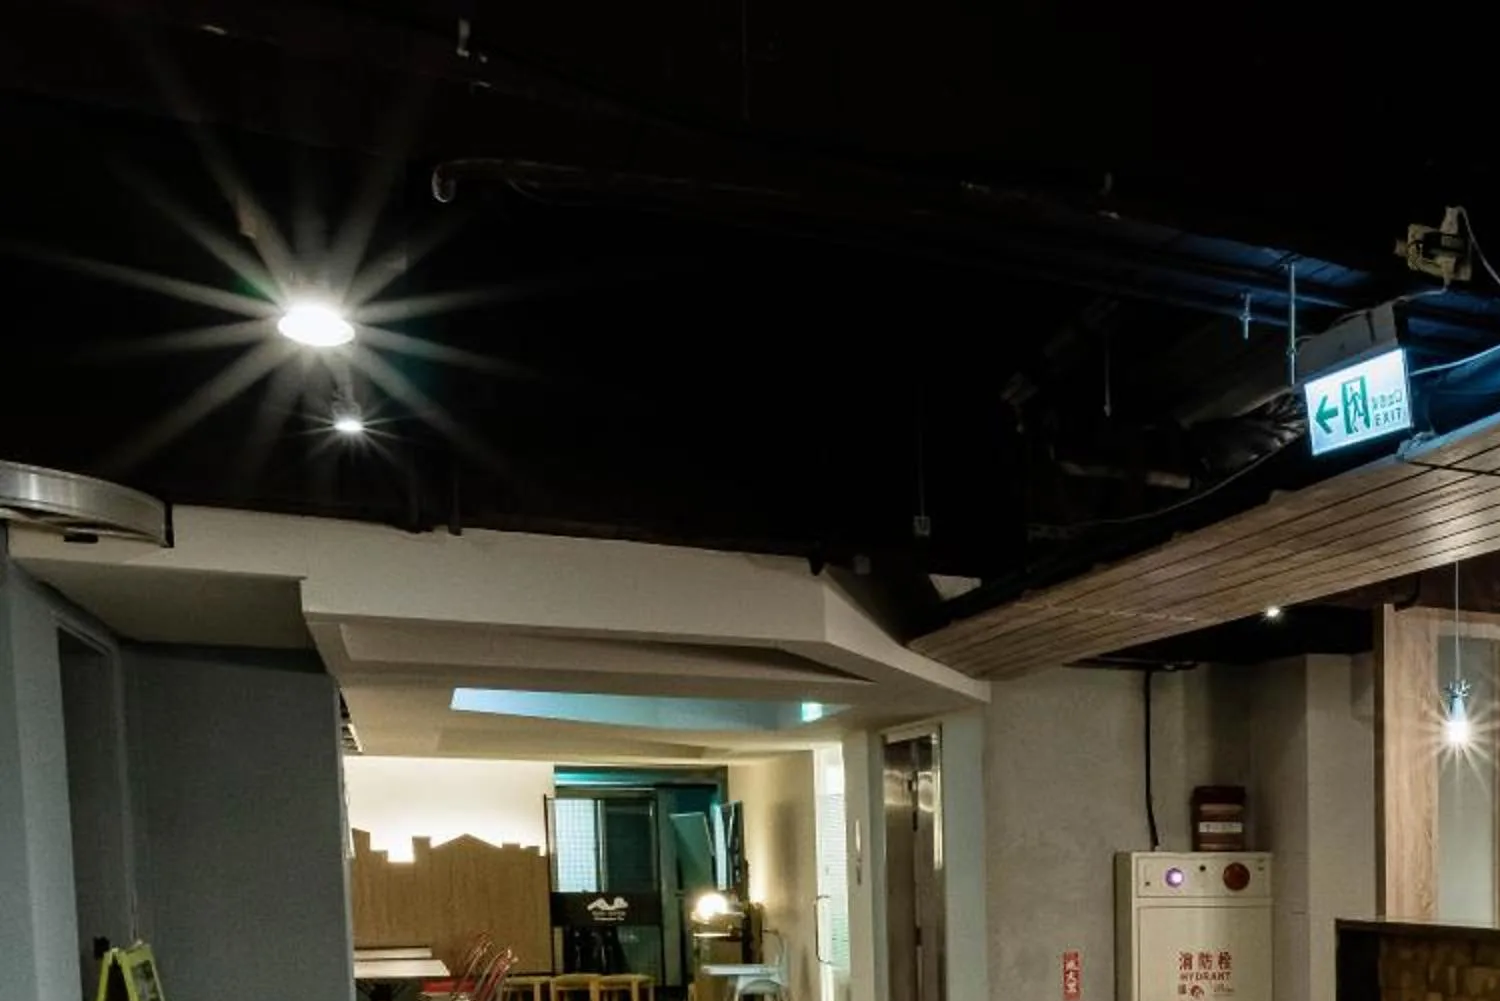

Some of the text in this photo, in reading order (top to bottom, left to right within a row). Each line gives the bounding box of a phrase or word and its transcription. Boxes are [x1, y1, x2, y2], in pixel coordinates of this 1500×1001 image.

[1375, 407, 1401, 426] EXIT
[1179, 951, 1232, 971] 消防栓
[1179, 971, 1231, 981] HYDRANT
